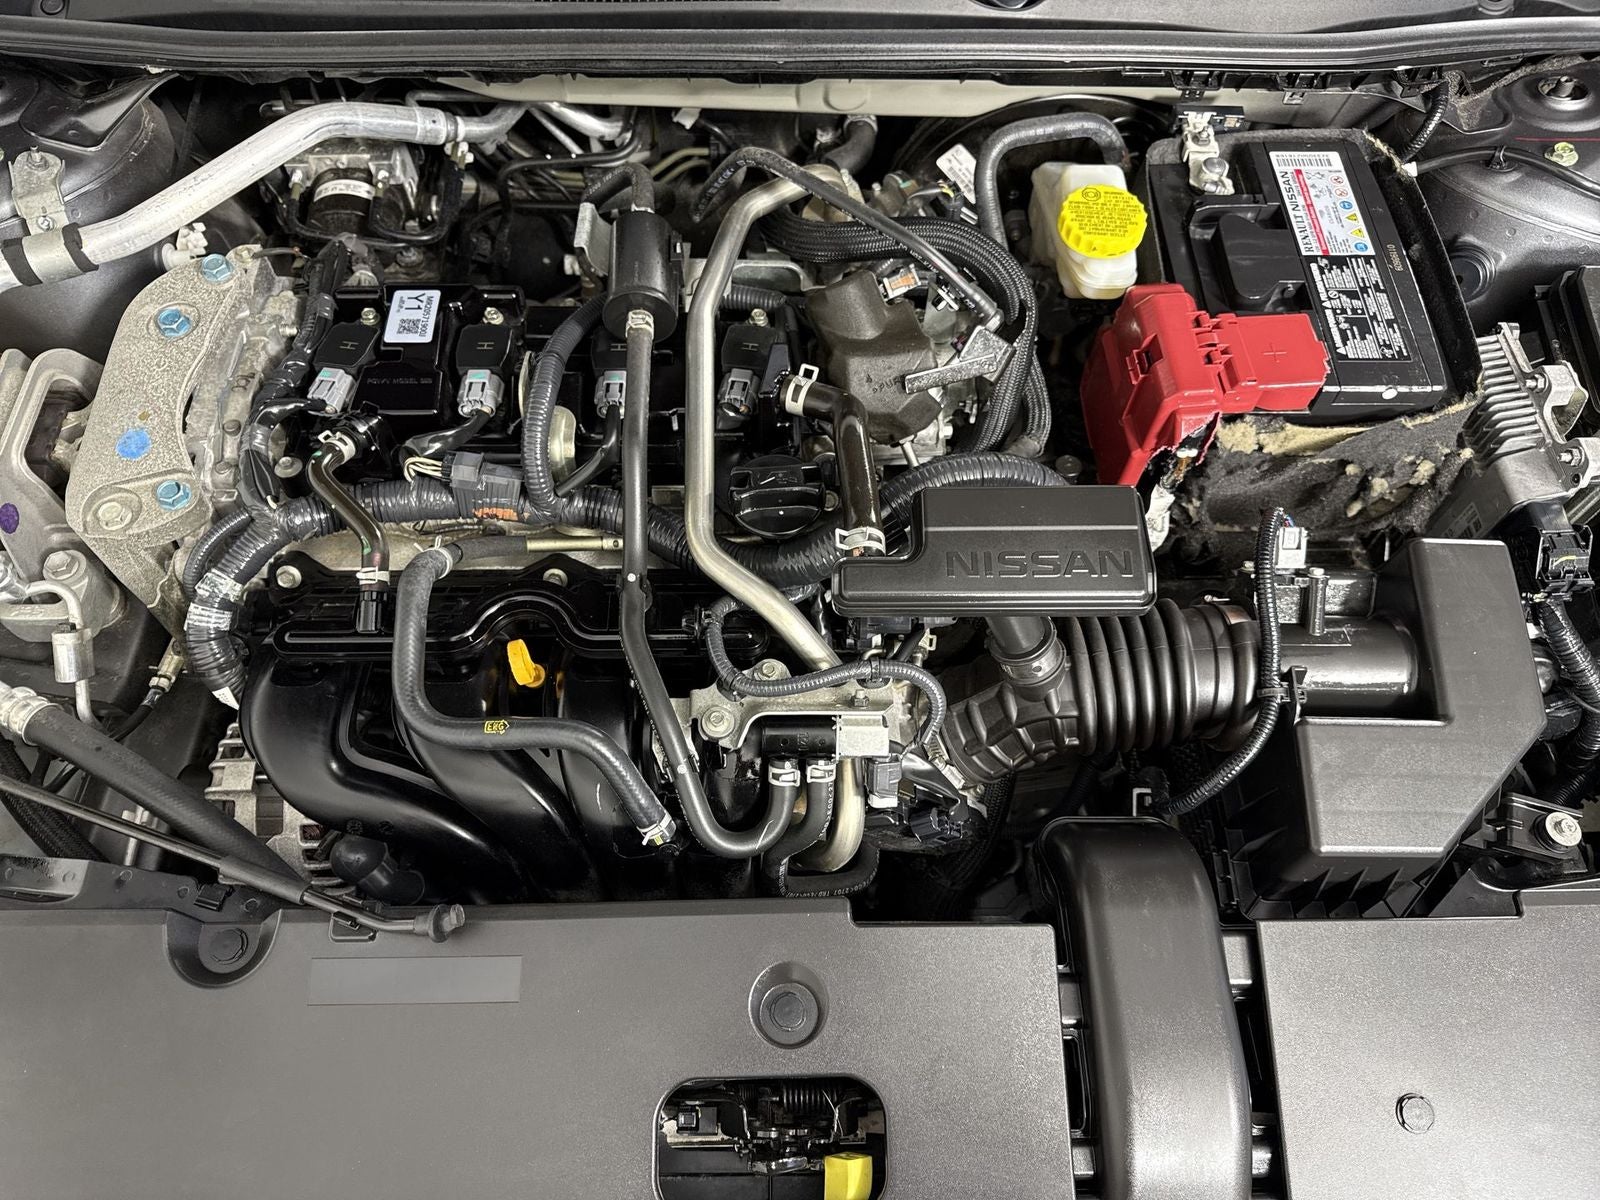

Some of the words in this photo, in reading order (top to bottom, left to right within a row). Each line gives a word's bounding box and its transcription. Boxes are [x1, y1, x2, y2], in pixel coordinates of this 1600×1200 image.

[1280, 170, 1301, 212] NISSAN
[1293, 214, 1315, 253] RENAULT
[405, 292, 425, 310] Y1
[945, 550, 1134, 578] NISSAN
